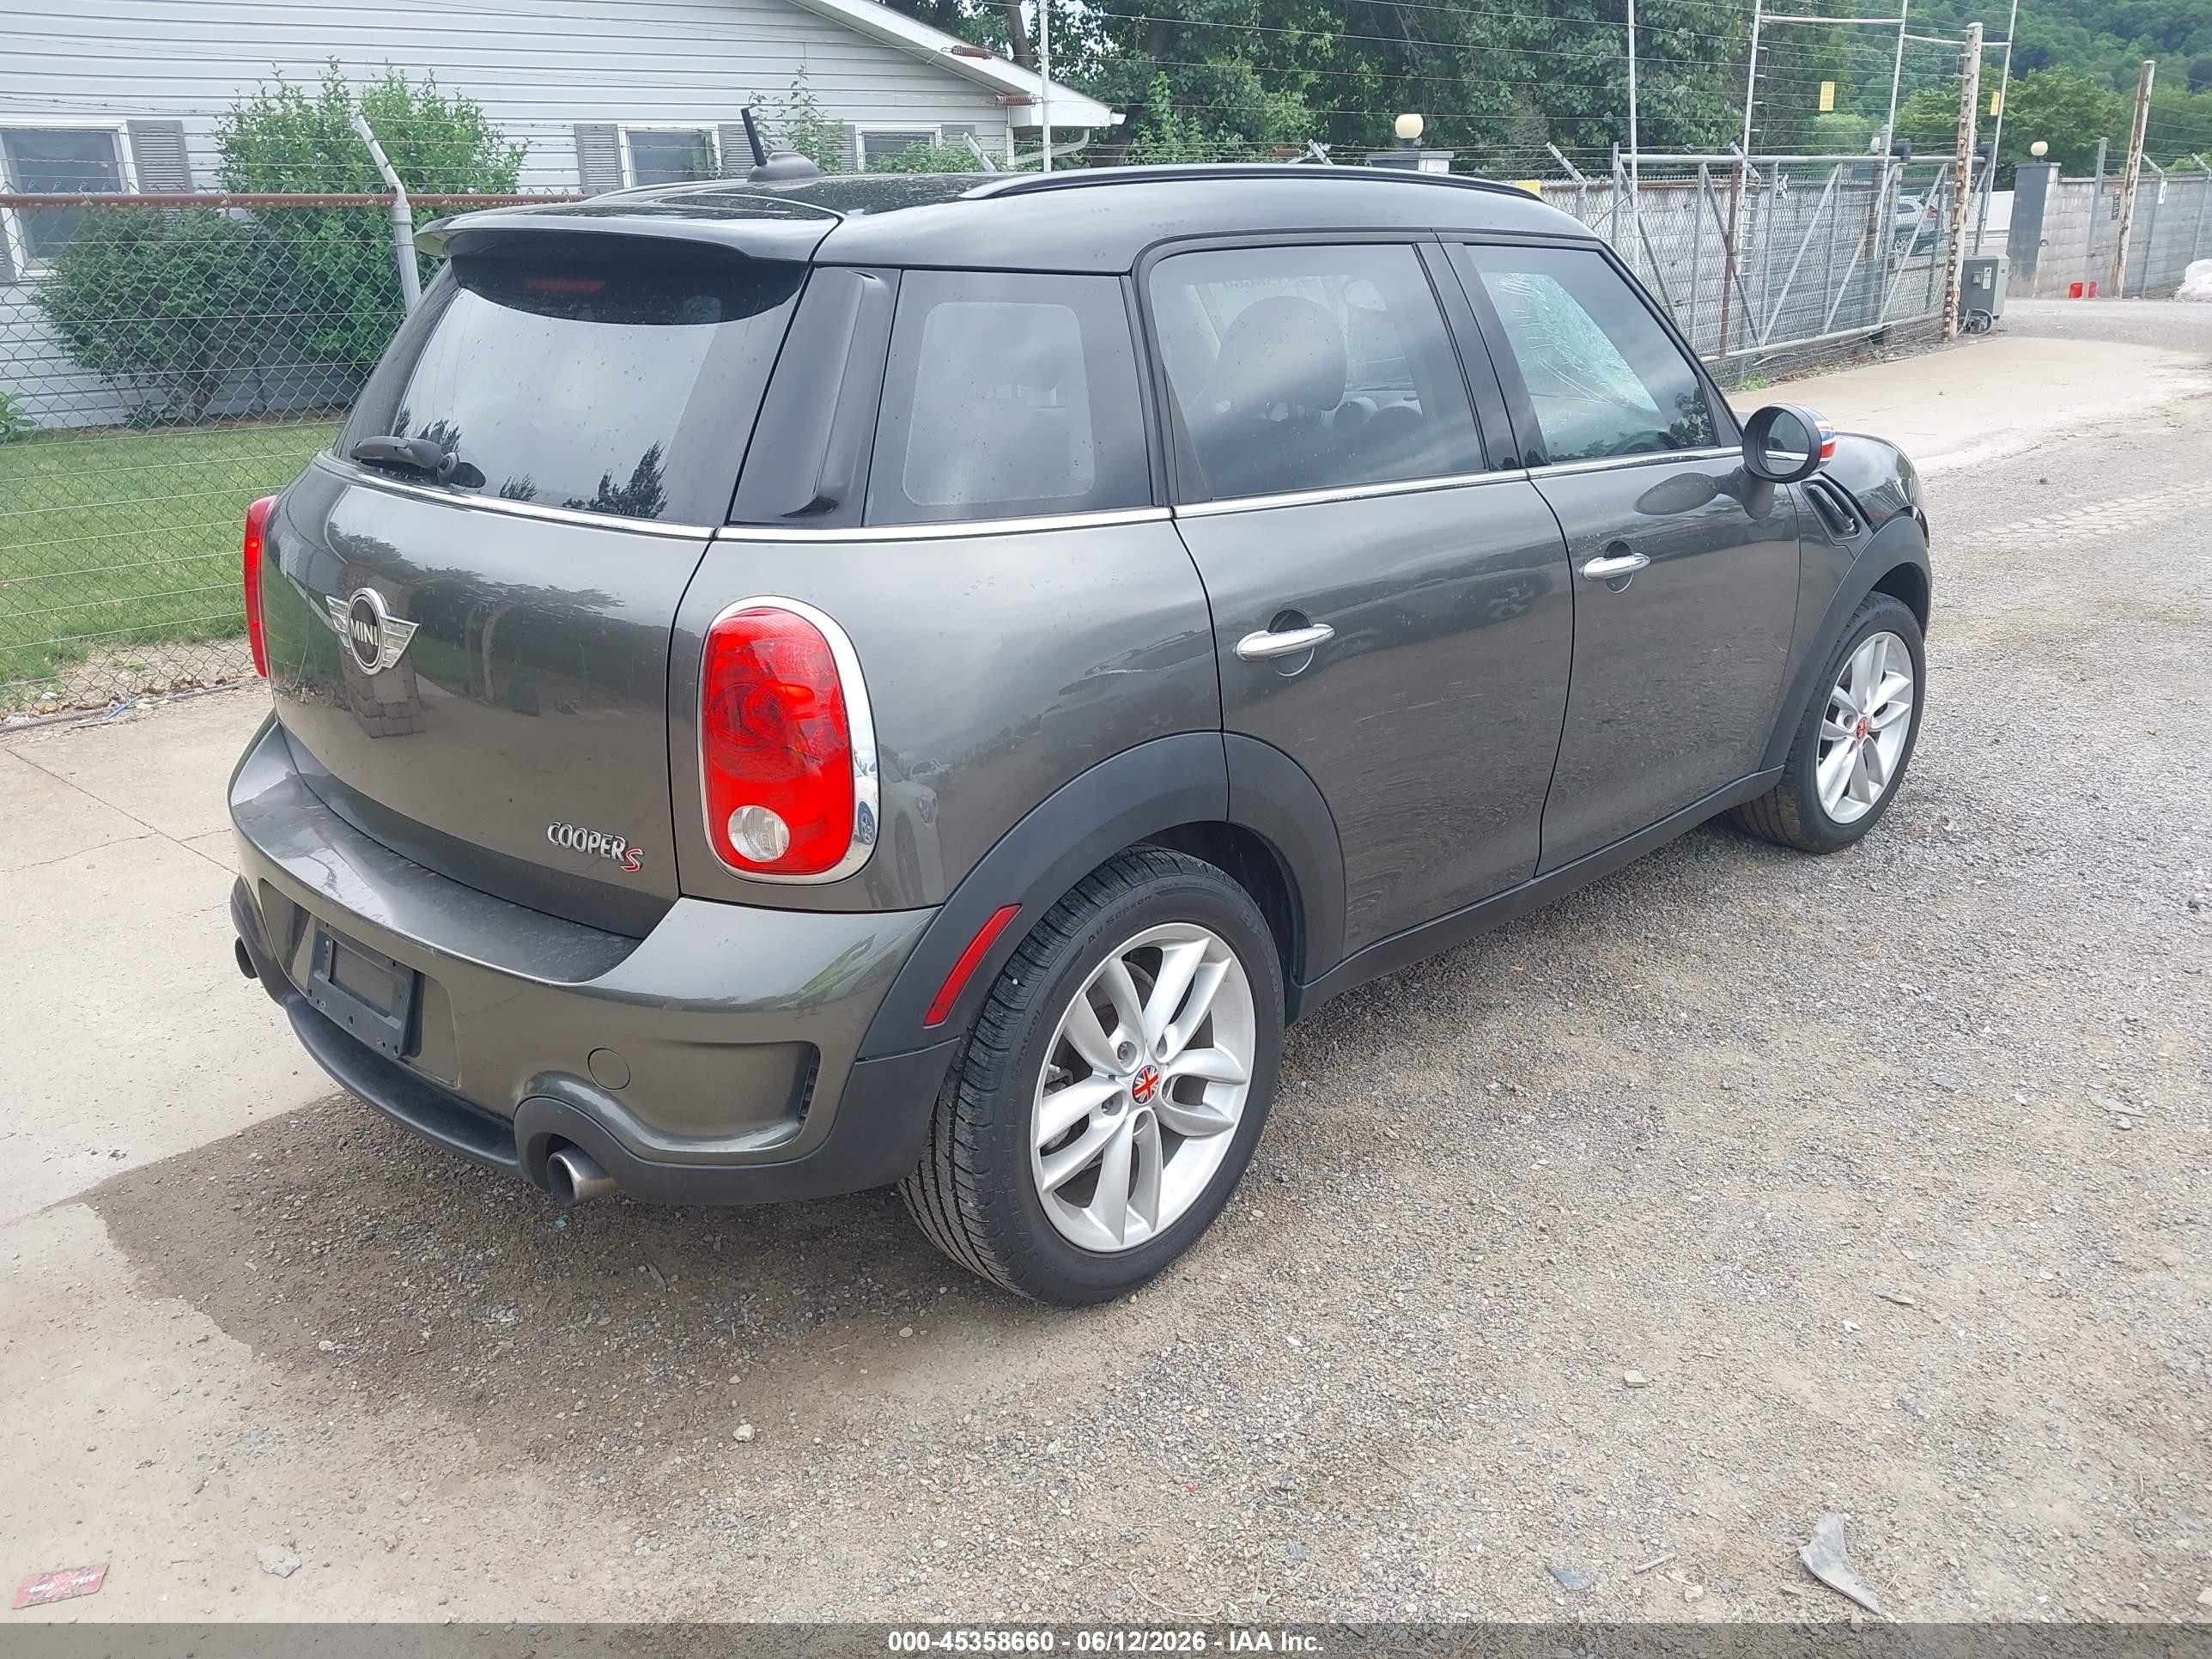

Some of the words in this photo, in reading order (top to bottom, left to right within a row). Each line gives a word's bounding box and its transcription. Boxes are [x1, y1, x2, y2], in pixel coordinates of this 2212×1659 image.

[349, 617, 379, 647] MINI
[547, 822, 625, 861] COOPER
[620, 848, 644, 872] S
